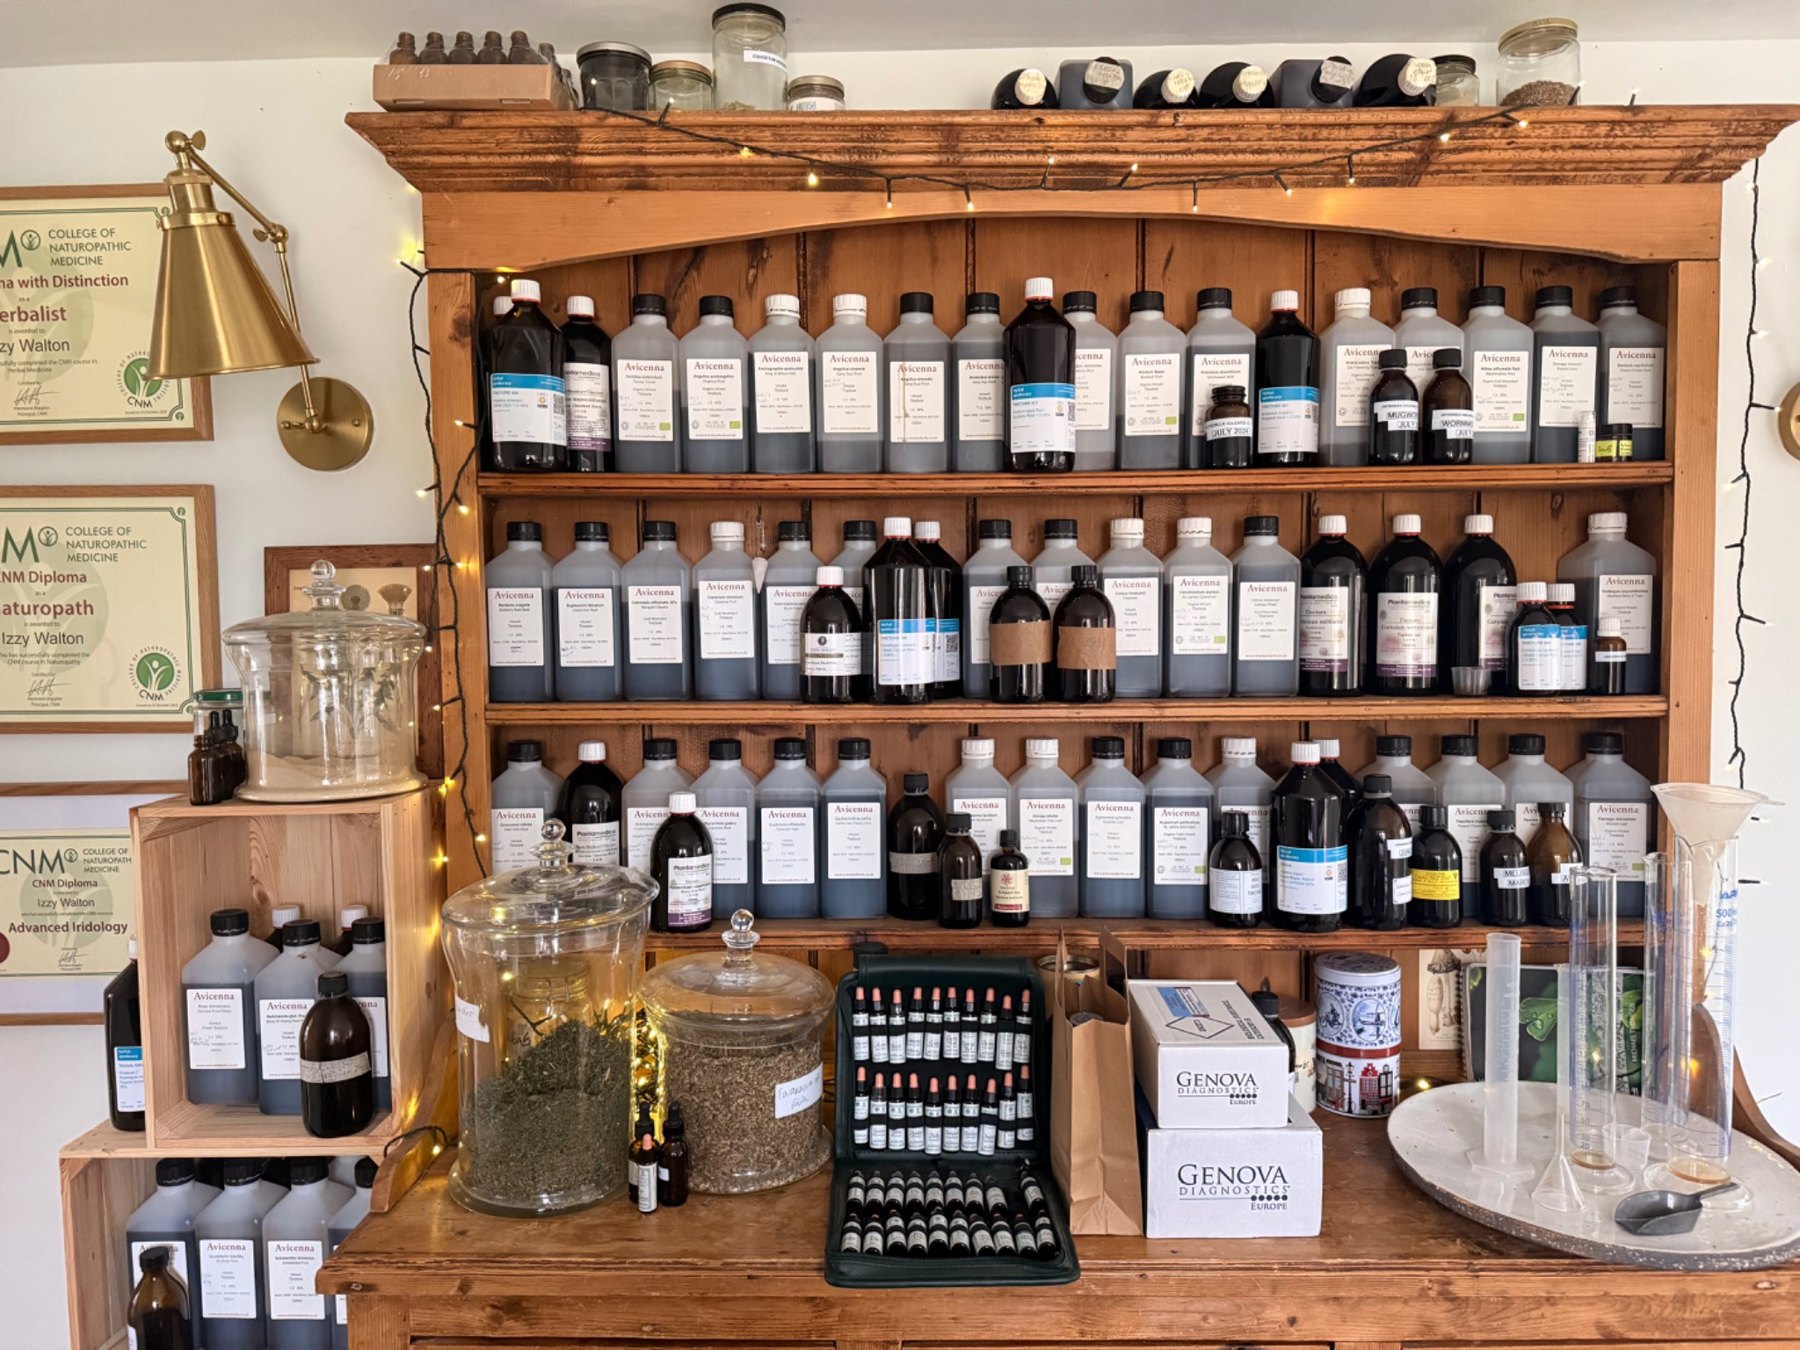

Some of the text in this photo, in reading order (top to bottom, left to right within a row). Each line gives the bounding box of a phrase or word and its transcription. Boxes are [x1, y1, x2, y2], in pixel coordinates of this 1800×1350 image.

[48, 227, 116, 240] COLLEGE OF
[49, 241, 132, 253] NATUROPATHIC
[50, 256, 104, 267] MEDICINE
[18, 274, 49, 289] with
[52, 273, 129, 289] Distinction
[20, 338, 70, 353] Walton
[1344, 347, 1381, 358] Avicenn
[1548, 348, 1588, 359] Avicenna
[1616, 349, 1657, 361] Avicenna
[762, 353, 801, 364] Avicenna
[829, 353, 870, 364] Avicenna
[1131, 356, 1172, 367] Avicenna
[1201, 356, 1242, 367] Avicenna
[1480, 353, 1521, 364] Avicenna
[625, 362, 665, 373] Avicenna
[694, 361, 734, 372] Avicenna
[897, 363, 937, 374] Avicenna
[127, 394, 153, 409] CNM
[65, 526, 132, 538] COLLEGE OF
[66, 540, 148, 551] NATUROPATHIC
[66, 553, 119, 564] MEDICINE
[28, 570, 88, 587] Diploma
[1179, 577, 1220, 588] Avicenna
[1605, 576, 1645, 587] Avicenna
[705, 581, 746, 592] Avicenna
[1112, 579, 1152, 590] Avicenna
[1247, 583, 1288, 594] Avicenna
[494, 589, 534, 600] Avicenna
[564, 589, 605, 600] Avicenna
[635, 587, 675, 598] Avicenna
[1, 631, 84, 649] Izzy Walton
[137, 688, 165, 704] CNM
[834, 804, 873, 815] Avicenna
[960, 800, 999, 810] Avicenna
[1026, 800, 1066, 810] Avicenna
[1094, 802, 1134, 812] Avicenna
[1597, 803, 1639, 815] Avicenna
[495, 810, 537, 821] Avicenna
[768, 809, 807, 820] Avicenna
[1161, 808, 1200, 818] Avicenna
[83, 847, 129, 856] COLLEGE OF
[83, 856, 132, 865] NATUROPATH
[83, 865, 120, 873] MEDICINE
[32, 878, 98, 892] CNM Diploma
[37, 897, 95, 912] Izzy Walton
[8, 920, 129, 936] Advanced Iridology
[194, 991, 235, 1002] Avicenna
[266, 1000, 308, 1011] Avicenna
[1176, 1071, 1257, 1087] GENOVA
[1177, 1086, 1257, 1095] DIAGNOSTICS
[1229, 1098, 1256, 1106] EUROPE
[1177, 1163, 1289, 1185] GENOVA
[1179, 1185, 1288, 1196] DIAGNOSTICS
[1250, 1202, 1288, 1211] EUROPE
[207, 1242, 247, 1253] Avicenna
[274, 1243, 315, 1254] Avicenna
